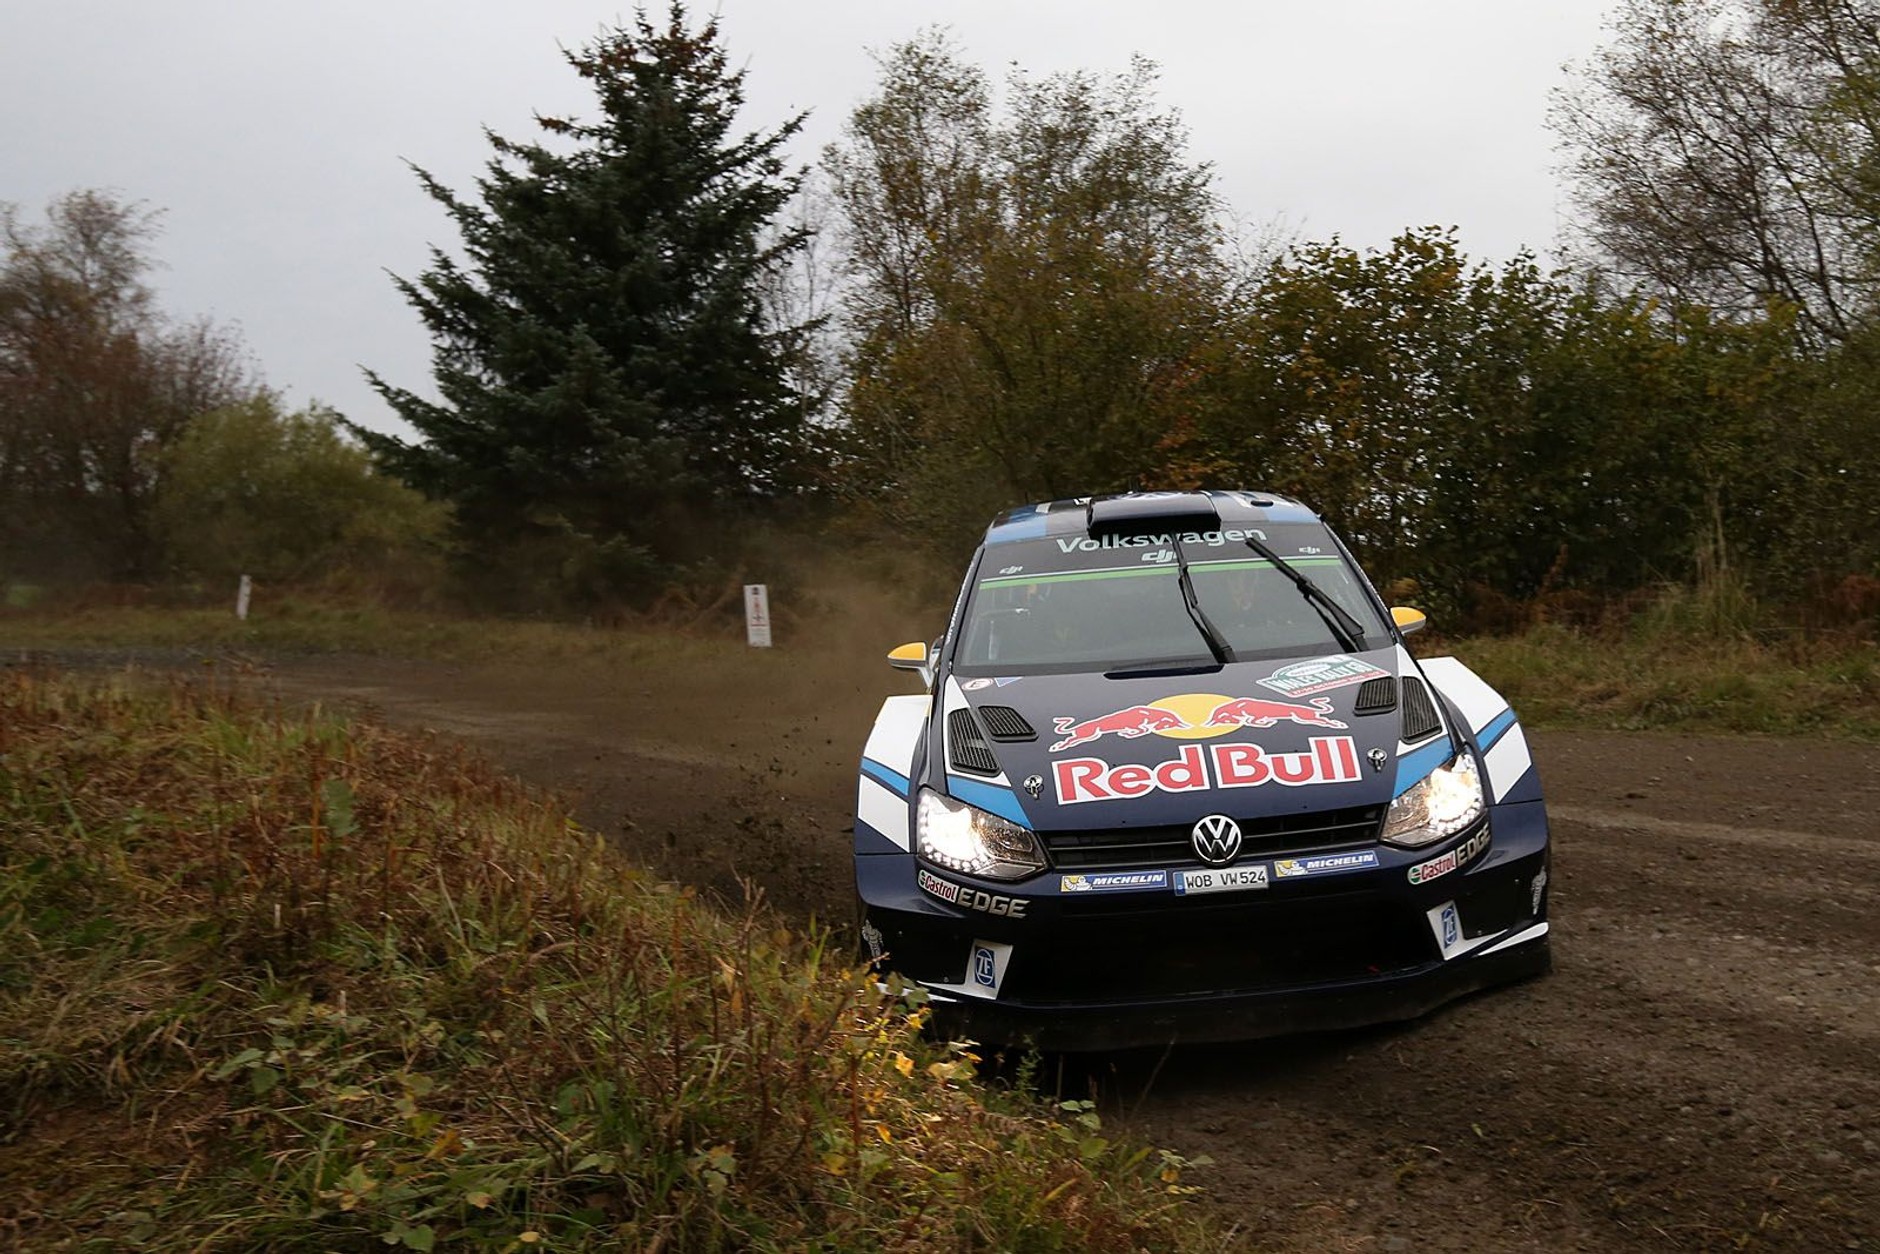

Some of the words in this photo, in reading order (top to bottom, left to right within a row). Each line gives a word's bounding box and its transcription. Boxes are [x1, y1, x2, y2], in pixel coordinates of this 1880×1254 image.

[1056, 528, 1268, 553] Volkswagen
[1054, 745, 1207, 803] Red
[1212, 737, 1360, 787] Bull
[1306, 854, 1374, 869] MICHELIN
[1421, 852, 1455, 880] Castrol
[1456, 821, 1491, 867] EDGE
[1092, 874, 1164, 885] MICHELIN
[1185, 874, 1213, 889] WOB
[1219, 872, 1238, 886] VW
[1239, 870, 1266, 884] 524
[924, 875, 957, 901] Castrol
[957, 887, 1031, 918] EDGE
[975, 952, 994, 981] ZF
